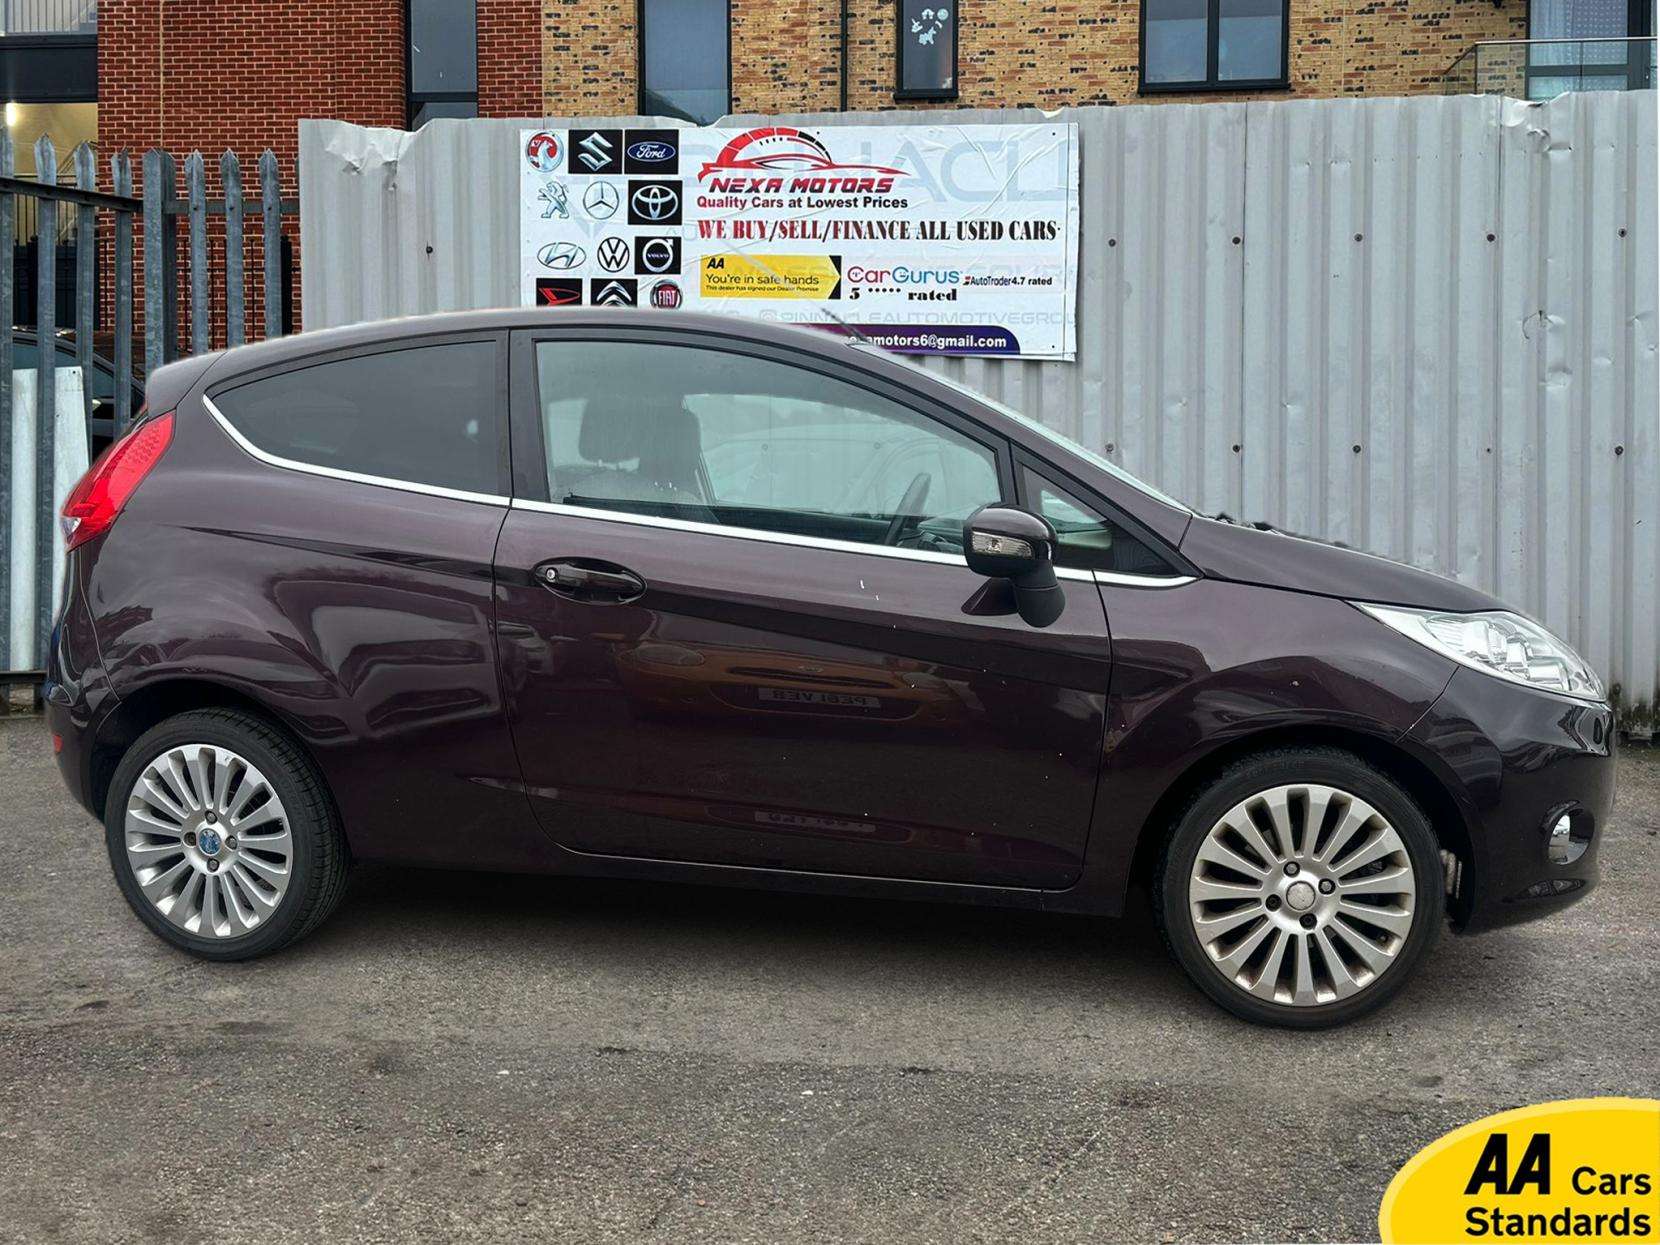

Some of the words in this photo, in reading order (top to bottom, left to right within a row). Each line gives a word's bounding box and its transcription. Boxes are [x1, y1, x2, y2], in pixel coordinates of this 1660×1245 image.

[637, 144, 667, 159] Ford
[709, 178, 783, 193] NEXA
[789, 178, 894, 193] MOTORS
[697, 196, 747, 210] Quality
[752, 196, 783, 208] Cars
[788, 197, 802, 208] at
[807, 196, 858, 208] Lowest
[863, 197, 908, 208] Prices
[698, 220, 726, 240] WE
[733, 220, 911, 242] BUY/SELL/FINANCE
[916, 220, 951, 240] ALL
[957, 220, 1003, 240] USED
[1009, 220, 1057, 240] CARS
[707, 257, 725, 269] AA
[706, 274, 740, 284] You're
[744, 274, 754, 284] in
[757, 274, 780, 284] safe
[784, 275, 819, 285] hands
[847, 266, 960, 284] CarGurus
[1028, 277, 1052, 286] rated
[658, 290, 676, 306] FIAT
[850, 288, 860, 300] 5
[908, 288, 957, 301] rated
[843, 334, 1007, 349] eamotors6@gmail.com
